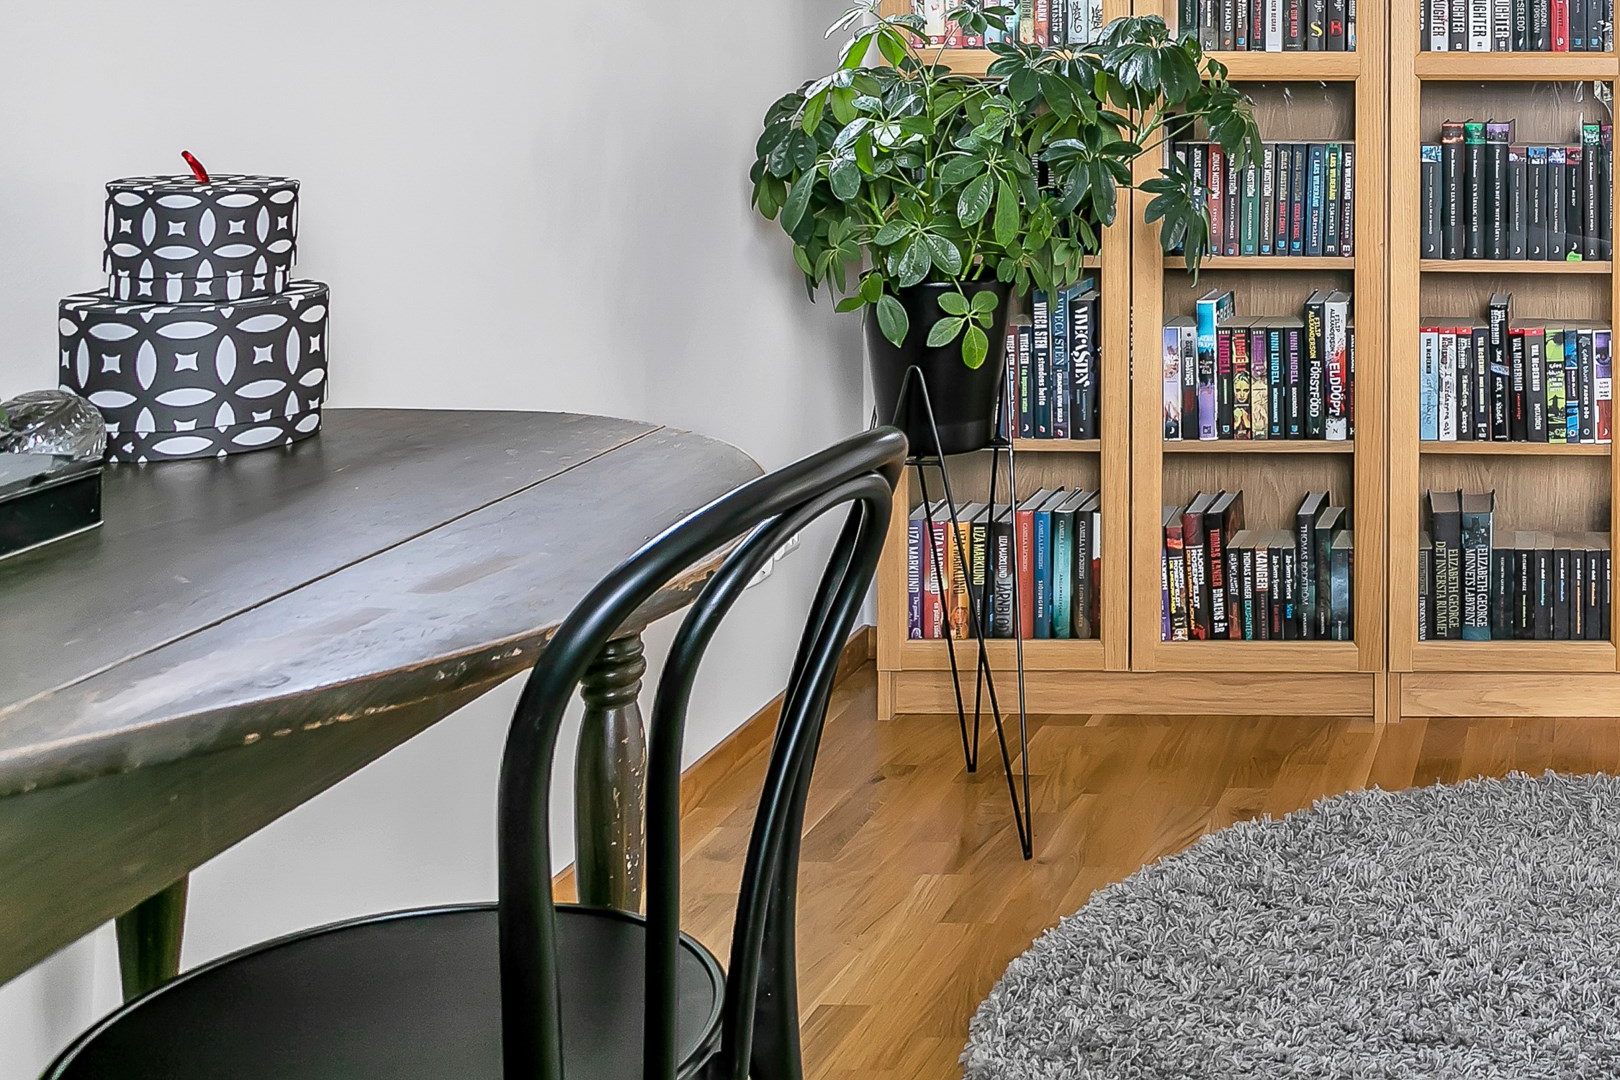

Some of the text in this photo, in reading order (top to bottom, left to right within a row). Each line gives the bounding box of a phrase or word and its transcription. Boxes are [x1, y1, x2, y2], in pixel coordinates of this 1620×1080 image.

[1224, 8, 1232, 32] HAND
[1212, 152, 1220, 172] JONAS
[1263, 149, 1272, 169] JONAS
[1344, 152, 1353, 167] LARS
[1033, 302, 1048, 349] VIVECA STEN
[1055, 338, 1064, 366] STEN
[1271, 331, 1279, 385] UNNI LINDELL
[1290, 331, 1298, 385] UNNI LINDELL
[1513, 338, 1522, 392] VAL McDERMID
[1531, 357, 1540, 392] McDERMID
[1309, 361, 1322, 418] FÖRSTFÖDD
[1328, 362, 1343, 417] ELDDÖPT
[972, 526, 985, 585] LIZA MARKLUND
[1300, 524, 1308, 561] THOMAS
[1191, 550, 1200, 609] ROSENFELDT
[1197, 549, 1205, 585] HJORTH
[1211, 559, 1223, 587] KANGER
[1243, 551, 1252, 599] THOMAS KANGER
[1256, 551, 1268, 590] KANGER
[1435, 541, 1447, 637] DET INNERSTA RUMMET
[1448, 549, 1460, 629] ELIZABETH GEORGE
[1465, 548, 1476, 627] MINNETS LABYRINT
[1477, 547, 1488, 628] ELIZABETH GEORGE
[996, 581, 1012, 633] JÄRNBLOD
[1212, 588, 1227, 634] DRAKENS ÅR
